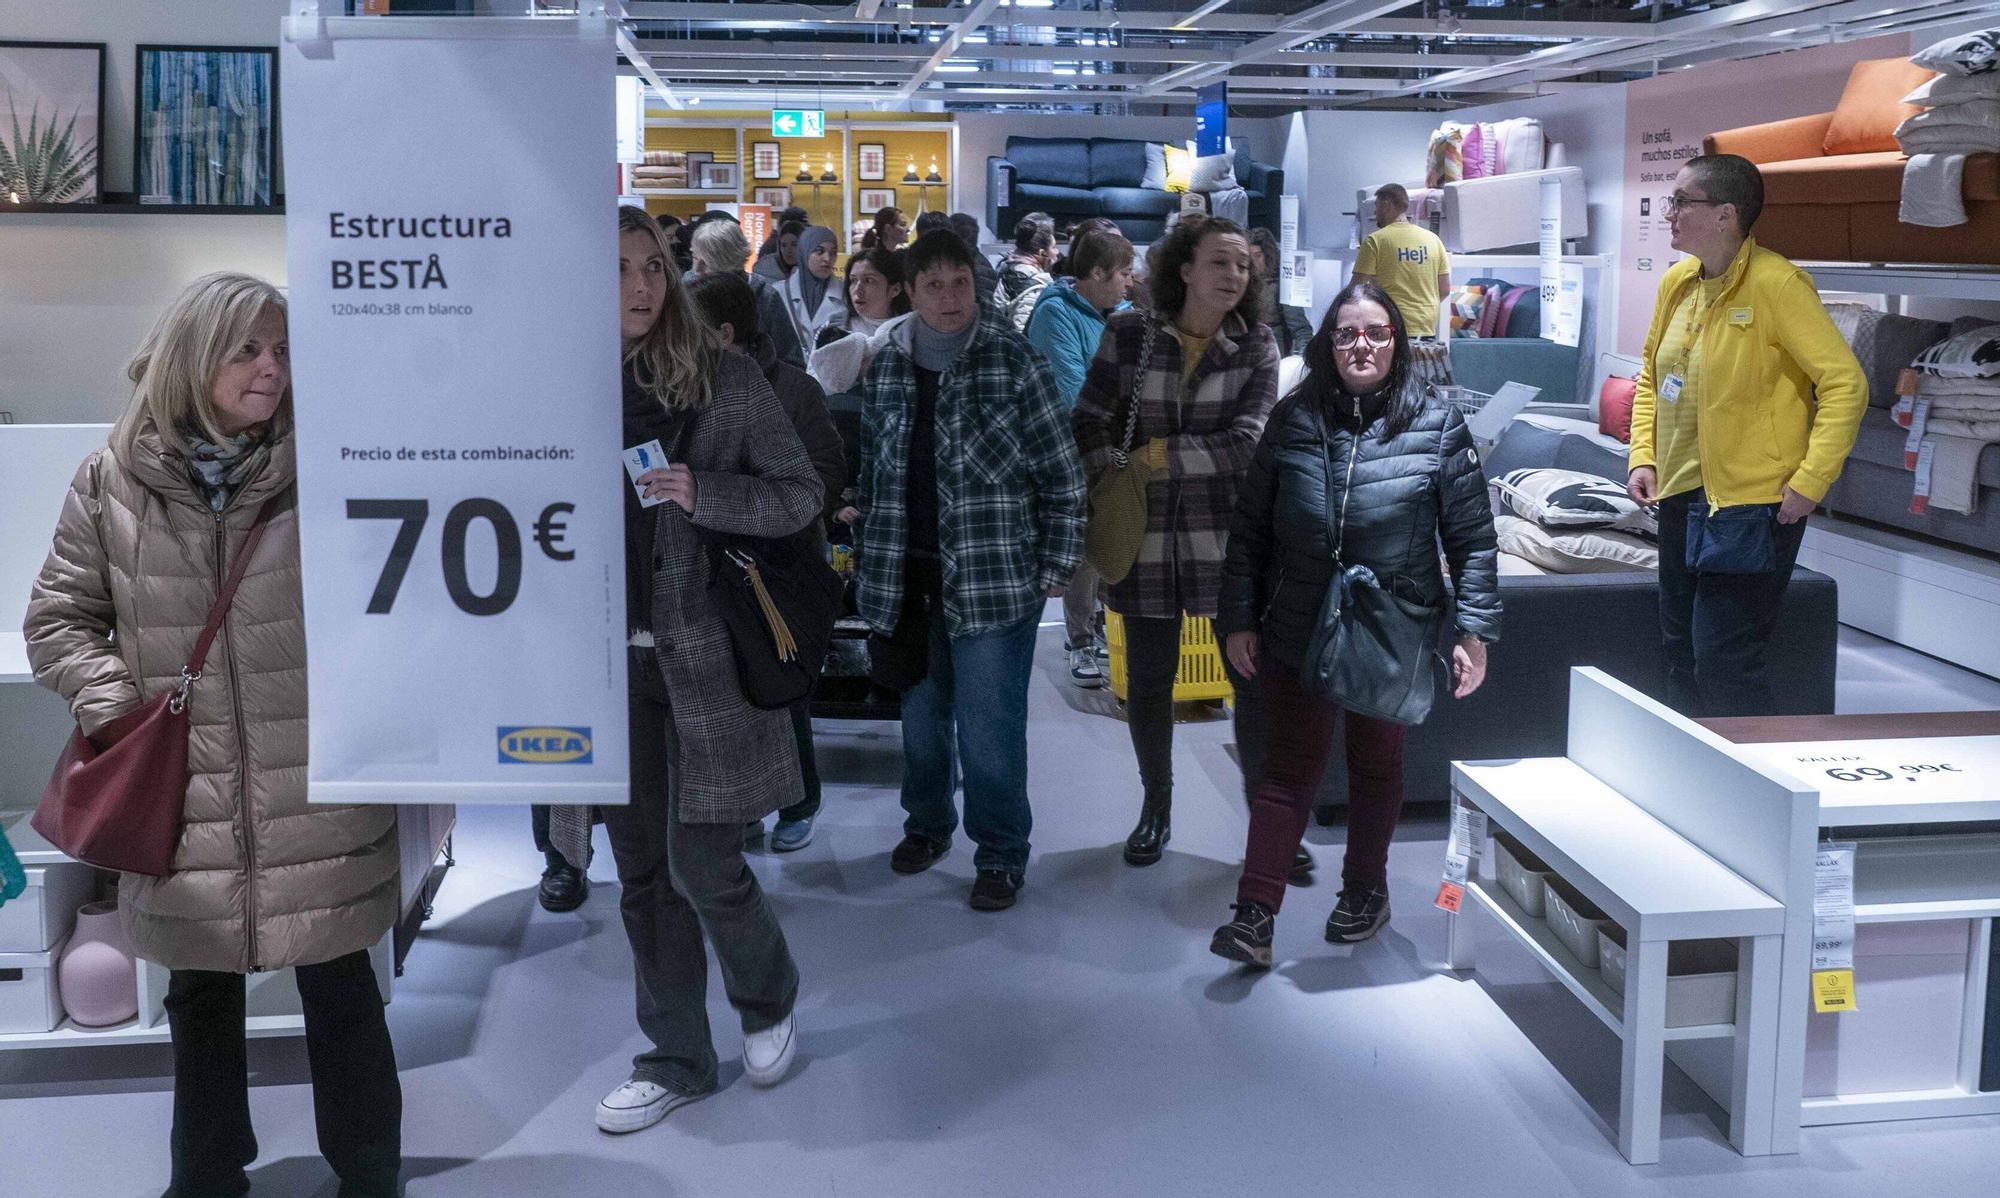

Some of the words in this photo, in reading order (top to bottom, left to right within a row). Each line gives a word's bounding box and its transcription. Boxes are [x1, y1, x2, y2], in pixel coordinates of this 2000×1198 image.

[1642, 131, 1654, 145] Un
[1641, 147, 1671, 162] muchos
[330, 212, 512, 238] Estructura
[1398, 246, 1428, 265] Hej!
[331, 253, 448, 289] BESTÅ
[332, 303, 401, 316] 120x40x38
[404, 305, 425, 316] cm
[428, 303, 473, 316] blanco
[341, 447, 396, 461] Precio
[397, 447, 417, 461] de
[421, 448, 457, 461] esta
[461, 446, 575, 460] combinación:
[508, 737, 584, 752] IKEA
